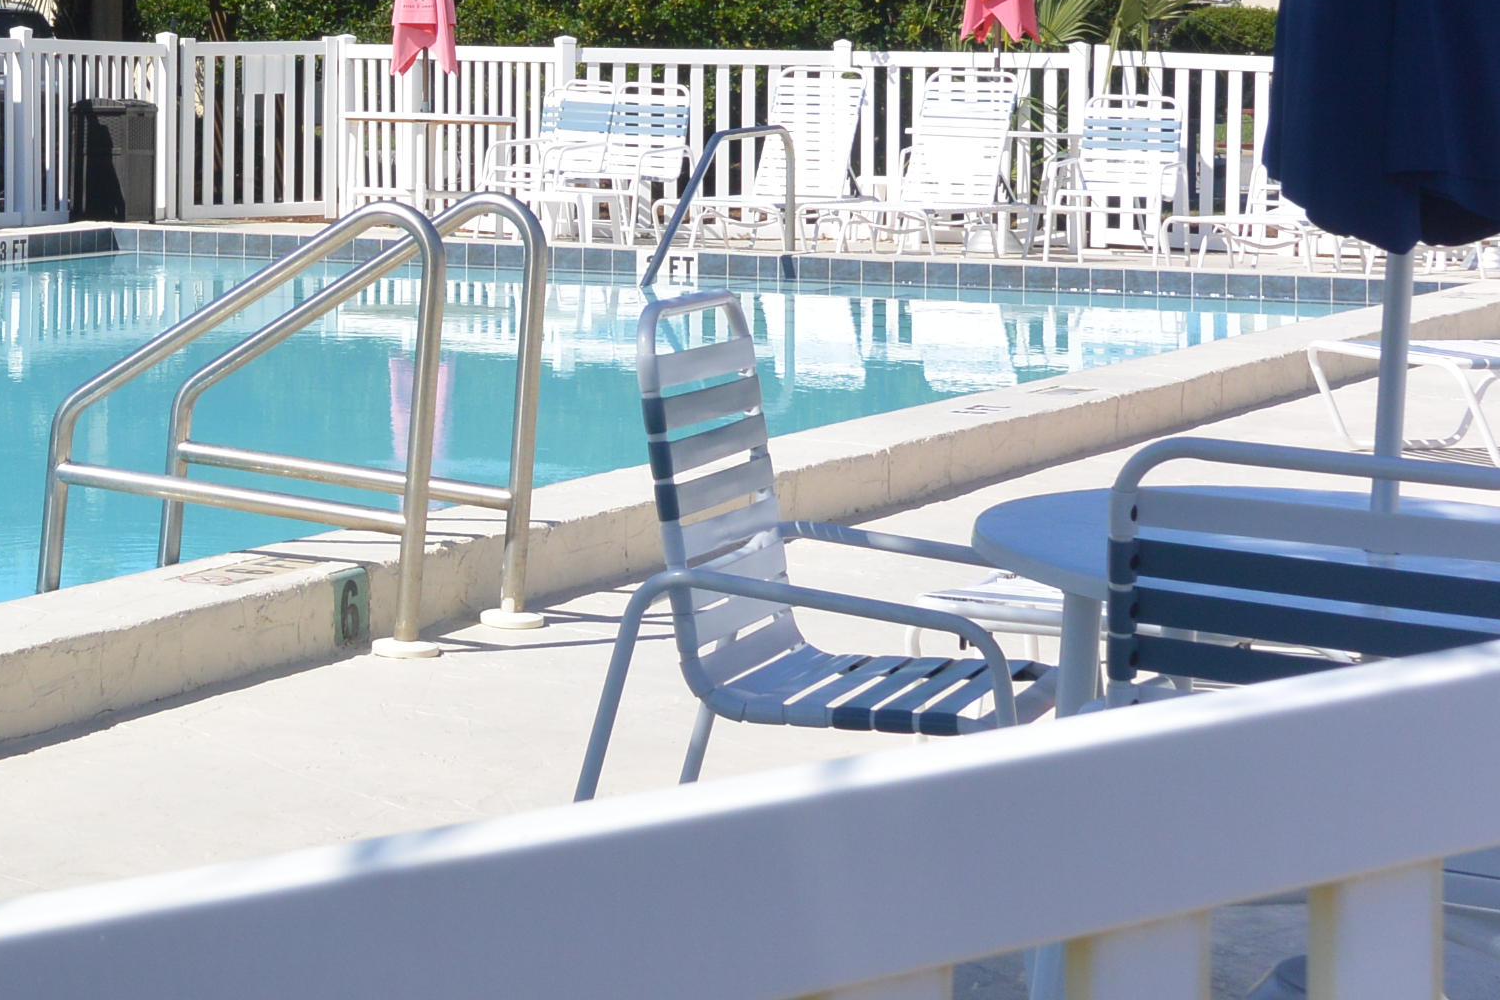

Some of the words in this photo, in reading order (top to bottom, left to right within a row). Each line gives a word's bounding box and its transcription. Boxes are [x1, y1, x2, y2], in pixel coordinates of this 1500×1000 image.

[0, 241, 7, 261] 3
[12, 239, 27, 261] FT
[669, 256, 695, 274] FT
[341, 579, 360, 641] 6
